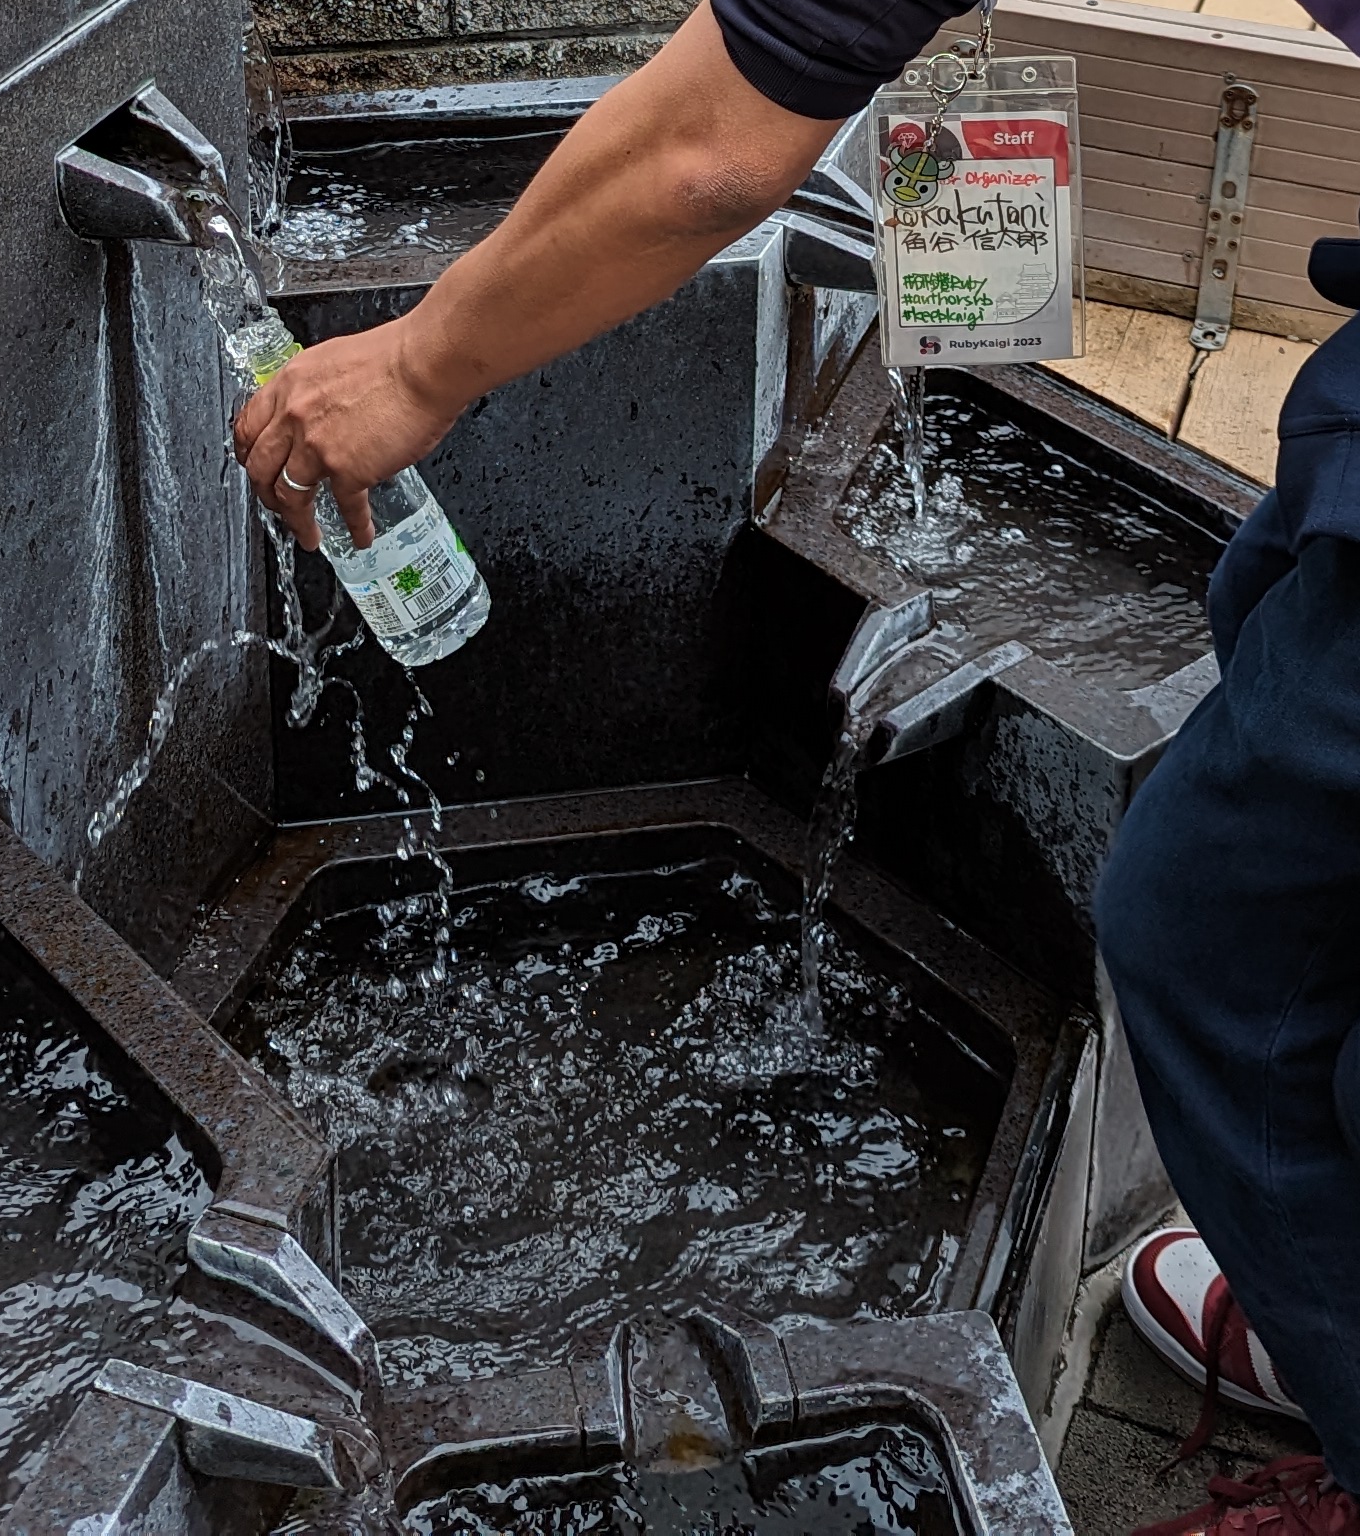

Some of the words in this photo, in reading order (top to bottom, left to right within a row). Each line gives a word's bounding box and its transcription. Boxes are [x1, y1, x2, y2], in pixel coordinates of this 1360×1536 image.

[993, 131, 1035, 146] Staff
[965, 170, 1047, 189] Organizer
[949, 338, 1011, 350] RubyKaigi
[1013, 337, 1042, 347] 2023
